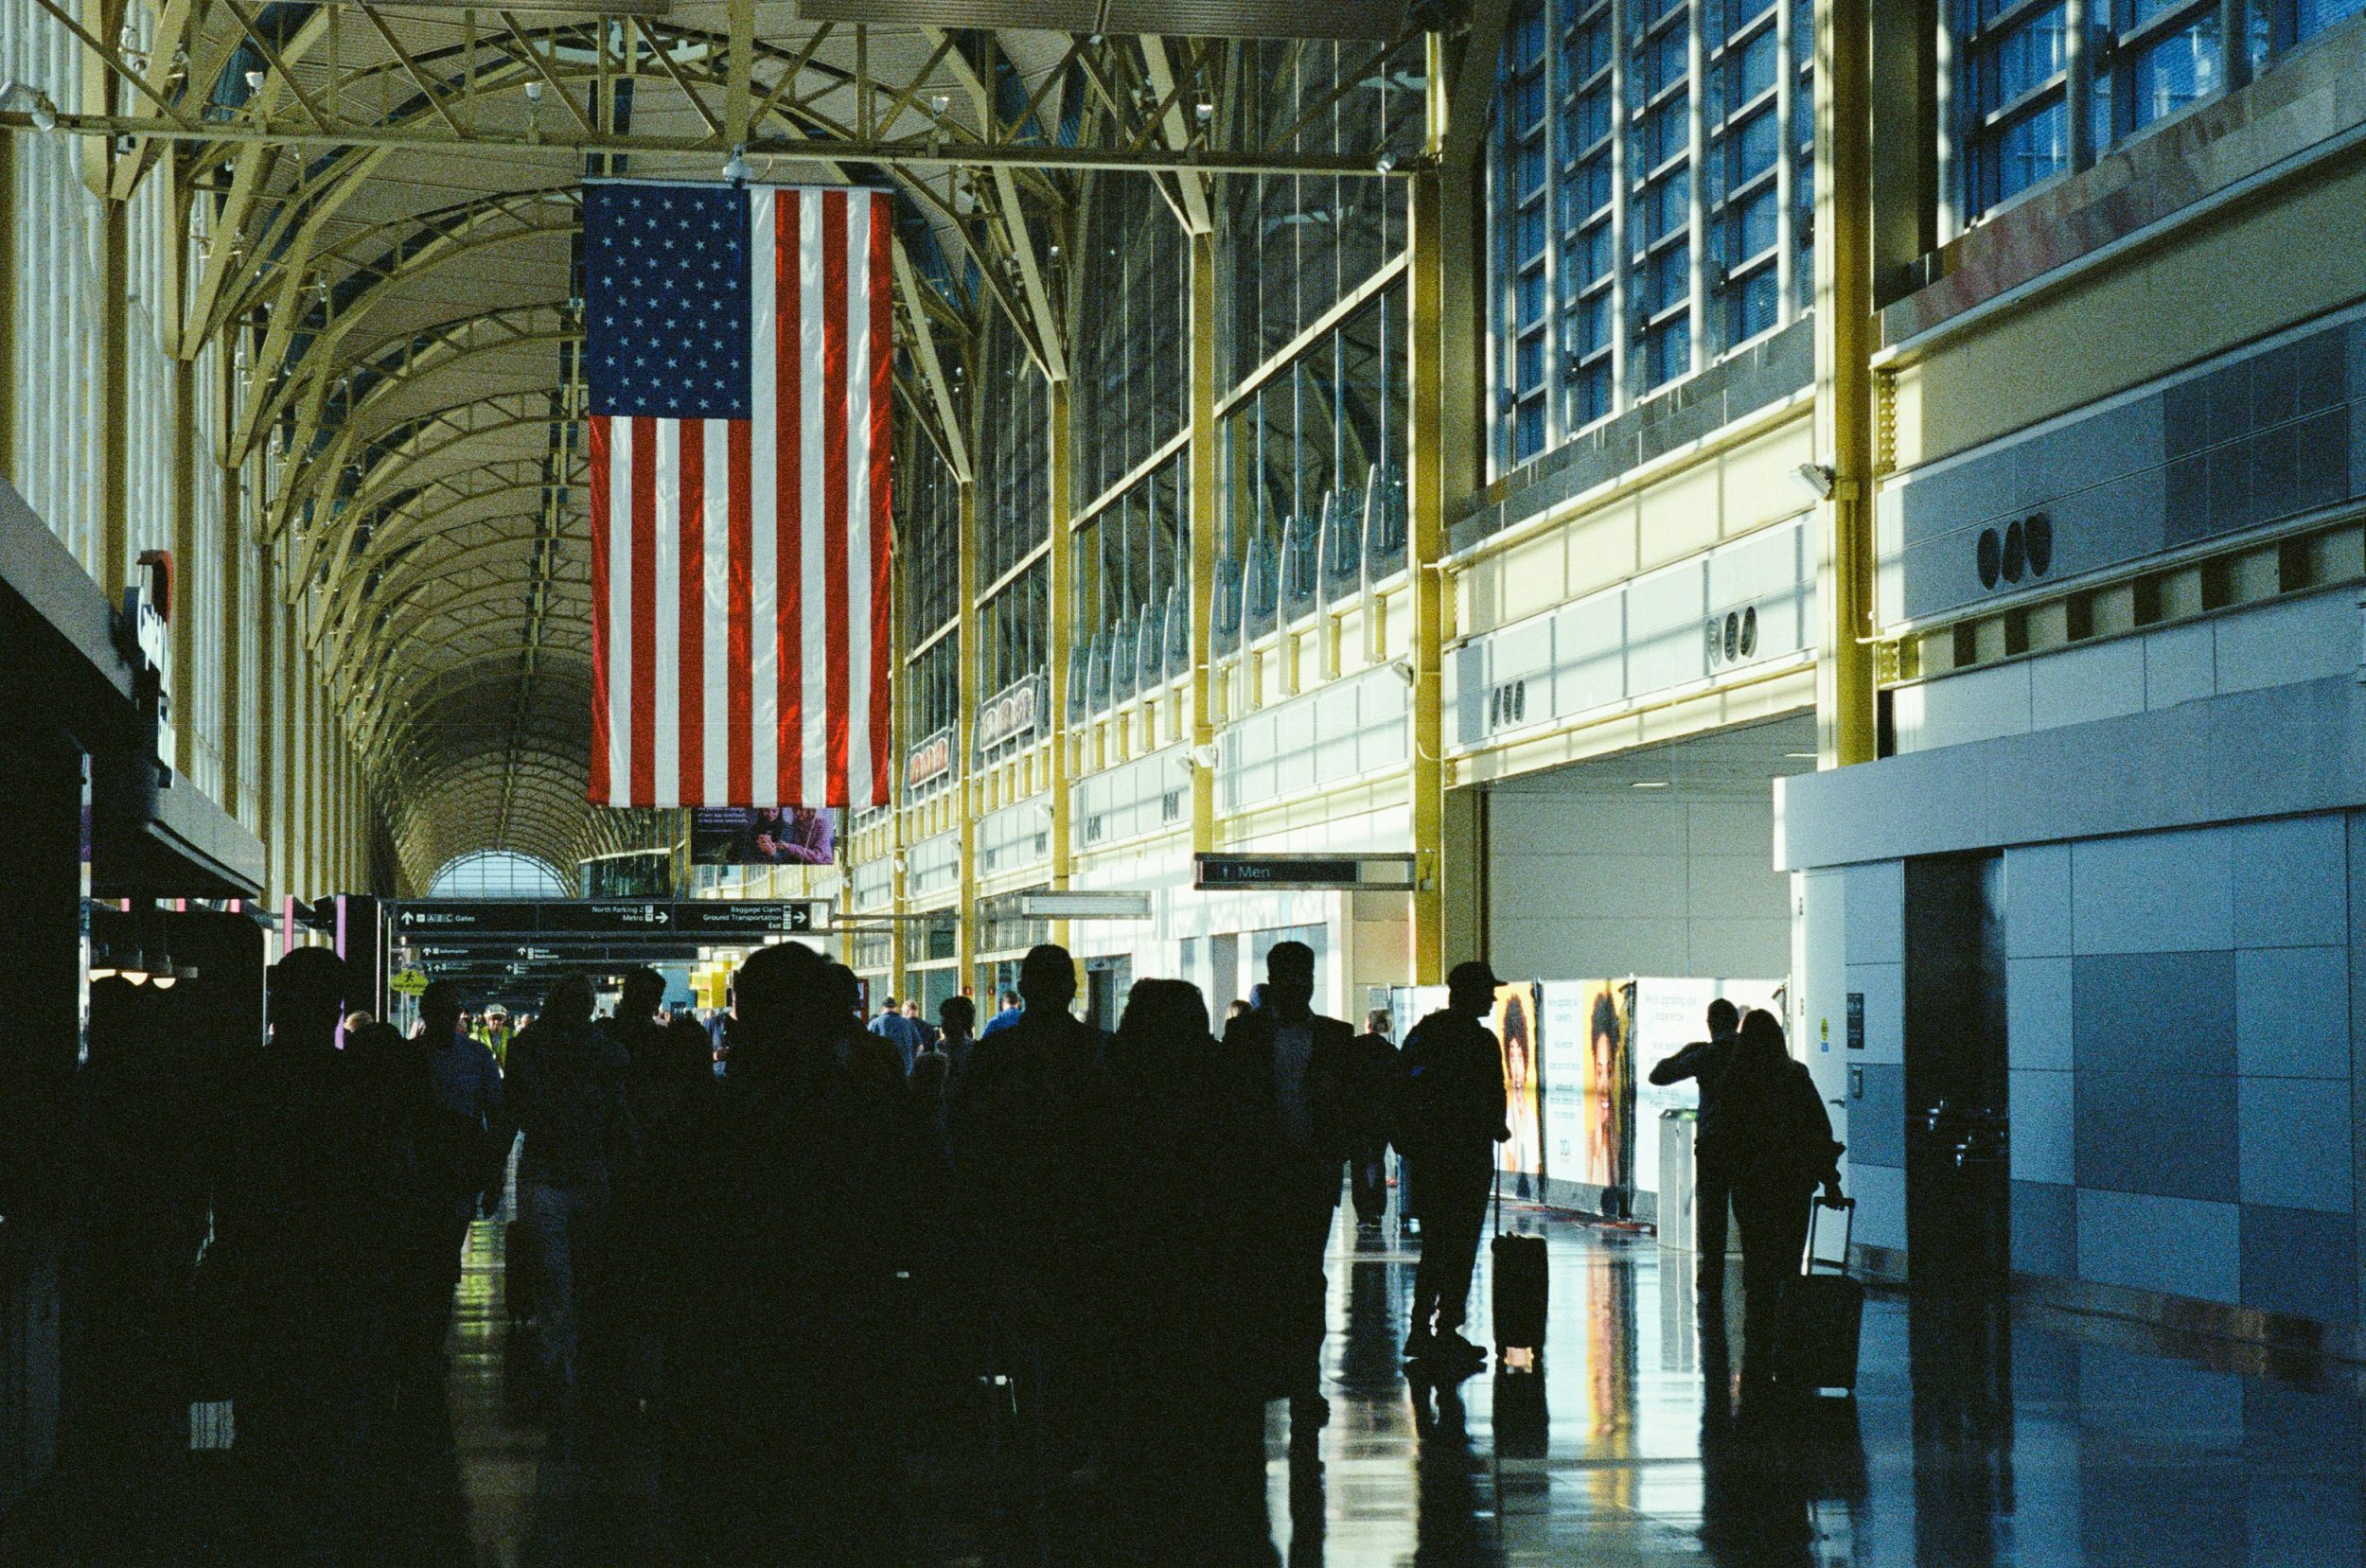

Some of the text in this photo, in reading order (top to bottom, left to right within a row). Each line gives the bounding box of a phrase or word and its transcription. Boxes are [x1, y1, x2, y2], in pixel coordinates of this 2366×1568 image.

[1238, 866, 1270, 878] Men
[612, 906, 638, 914] Parking
[731, 906, 761, 914] Baggage
